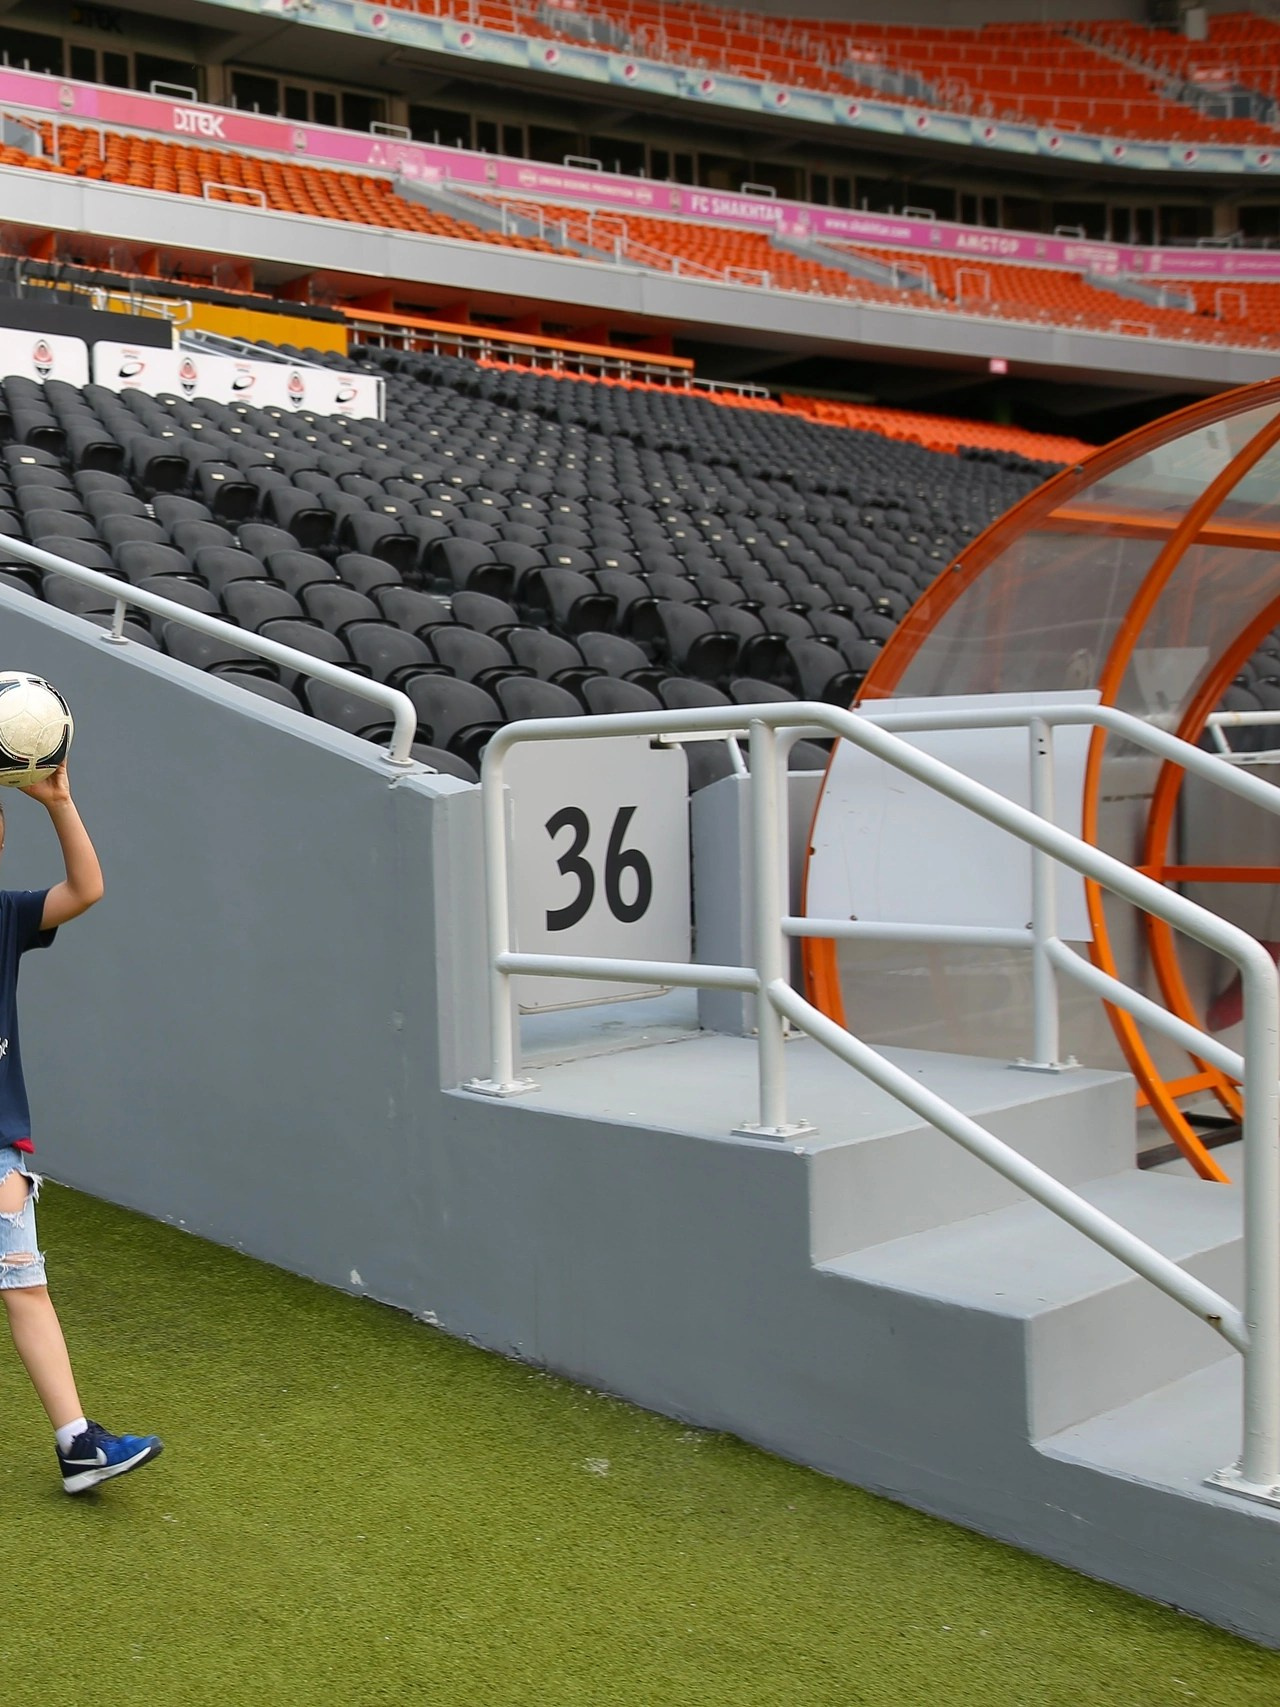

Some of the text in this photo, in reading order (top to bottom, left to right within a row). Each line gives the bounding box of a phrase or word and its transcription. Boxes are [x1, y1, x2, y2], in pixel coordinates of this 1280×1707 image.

[691, 194, 783, 221] FC SHAKHTAR
[544, 806, 653, 932] 36
